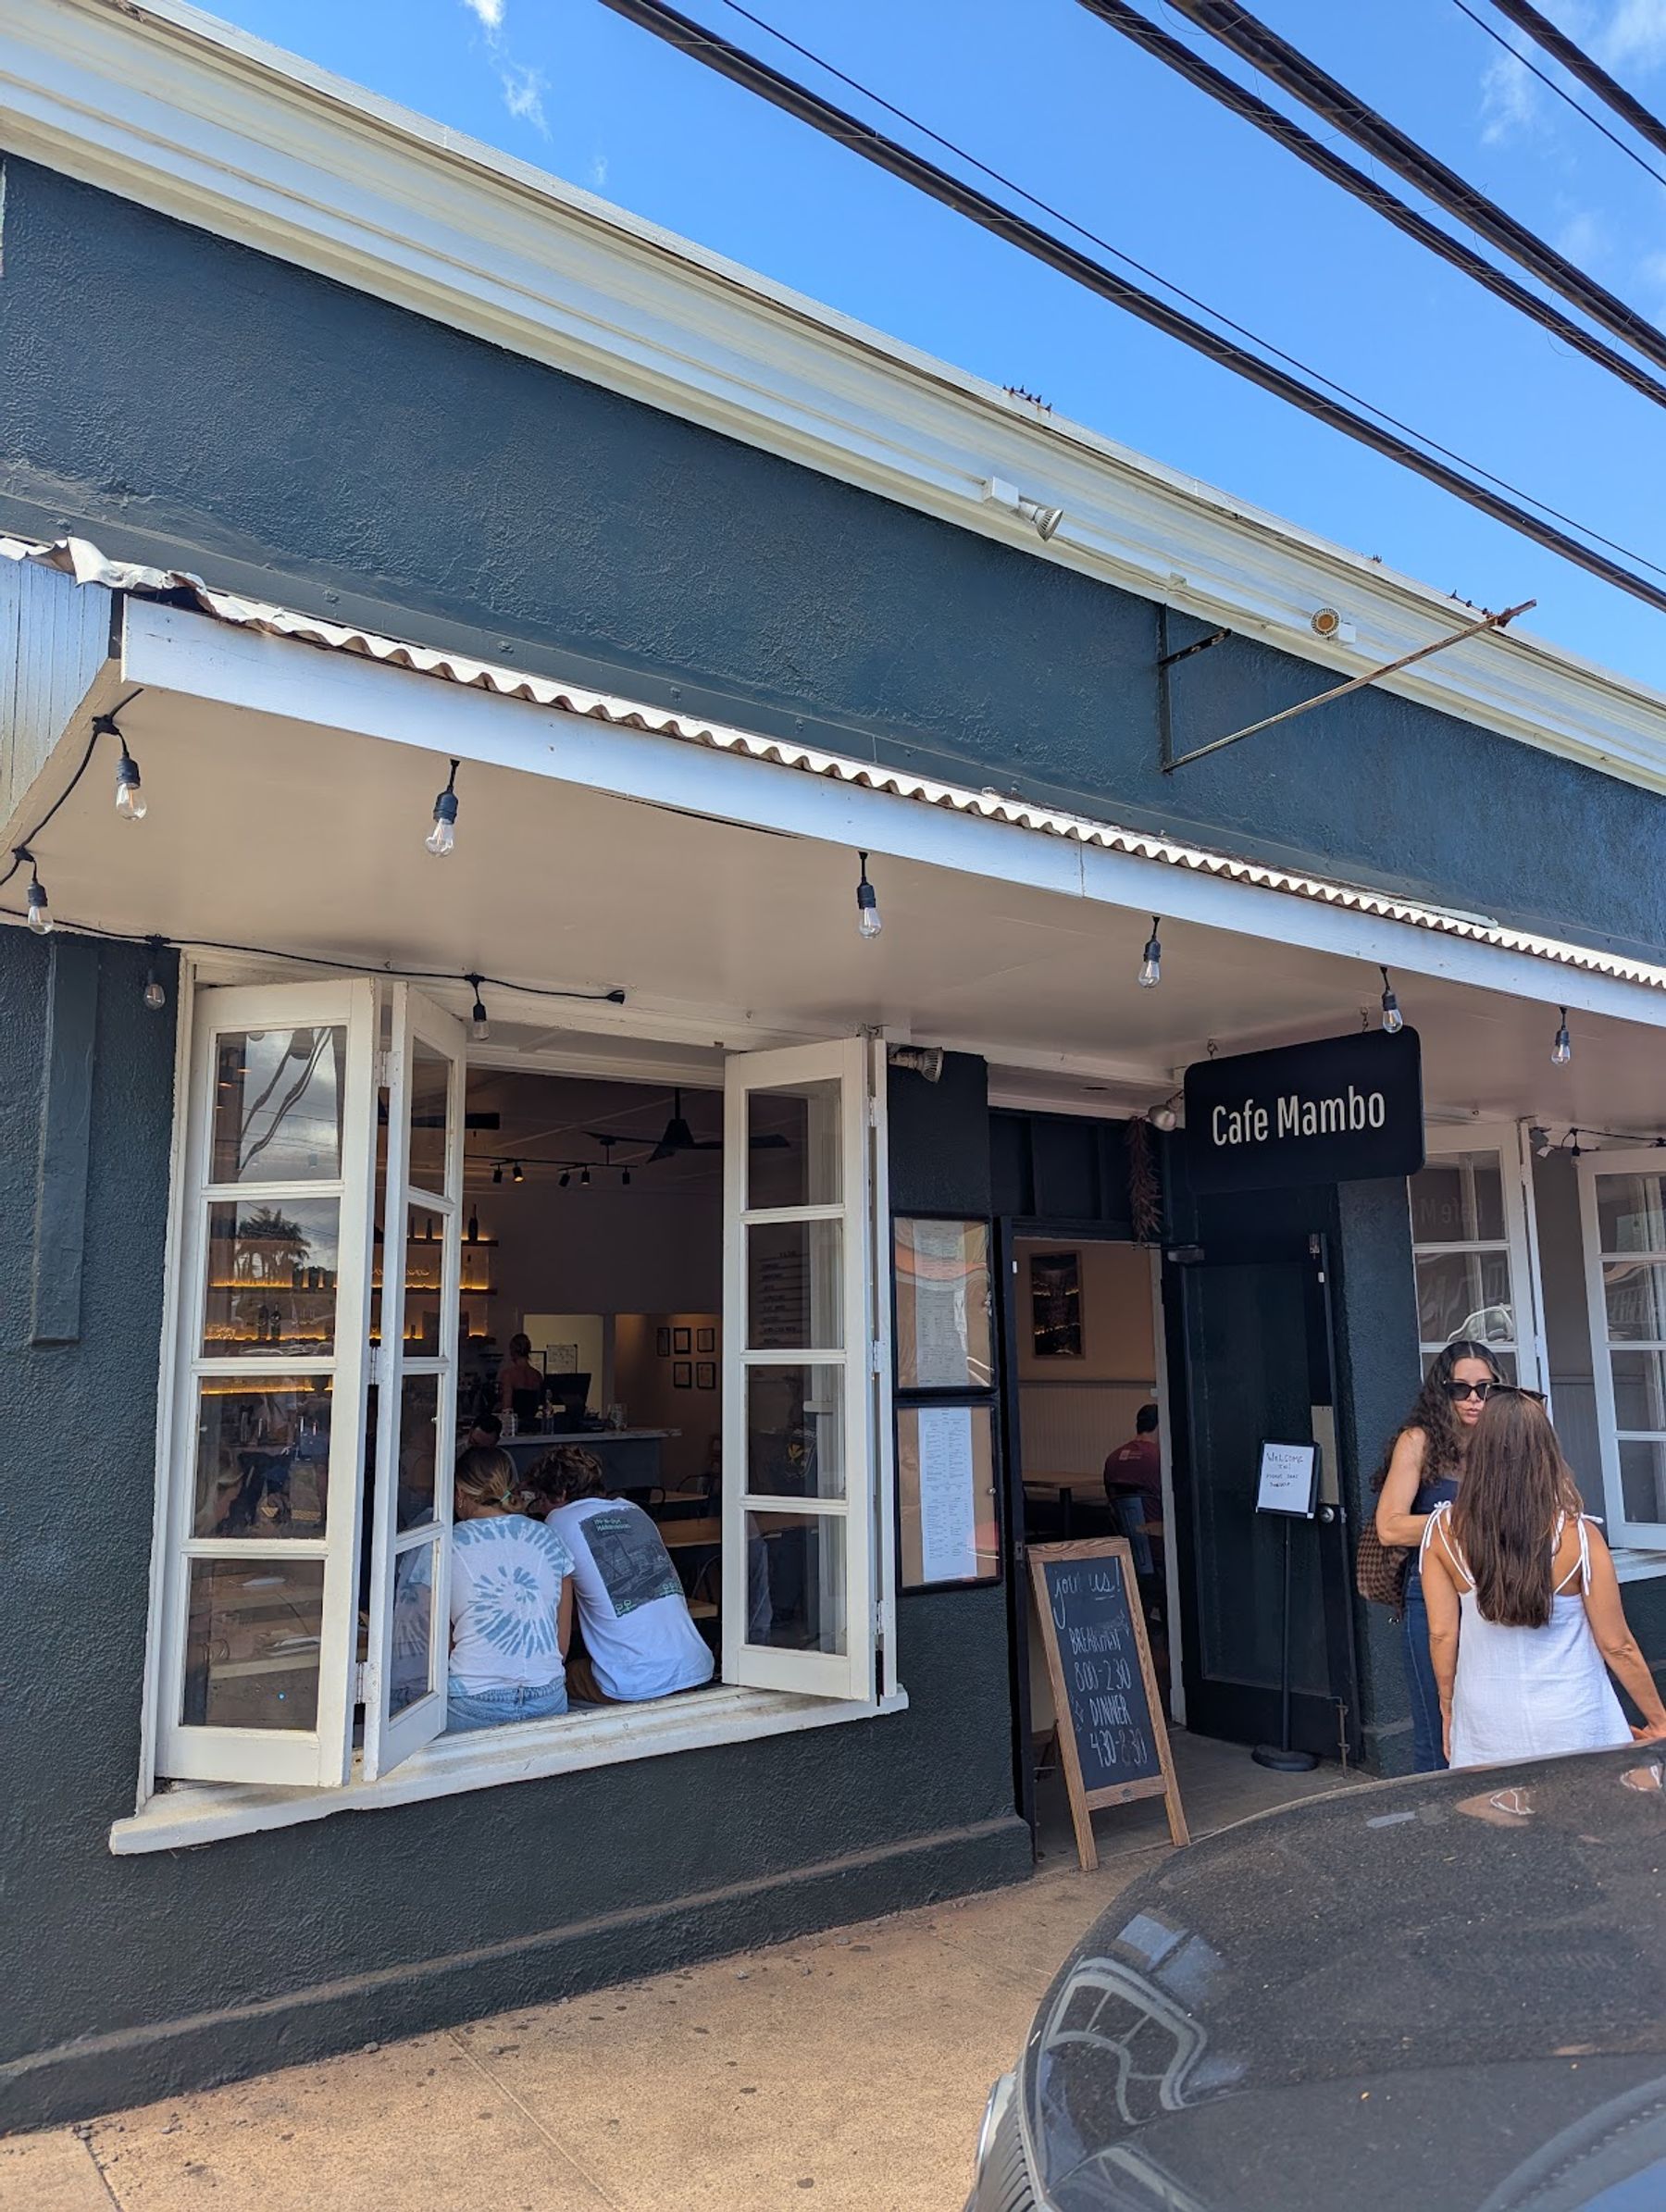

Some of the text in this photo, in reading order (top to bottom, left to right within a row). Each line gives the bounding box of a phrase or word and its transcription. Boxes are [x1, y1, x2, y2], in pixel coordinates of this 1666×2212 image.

[1212, 1085, 1386, 1146] Cafe Mambo
[1089, 1694, 1133, 1727] DINNER
